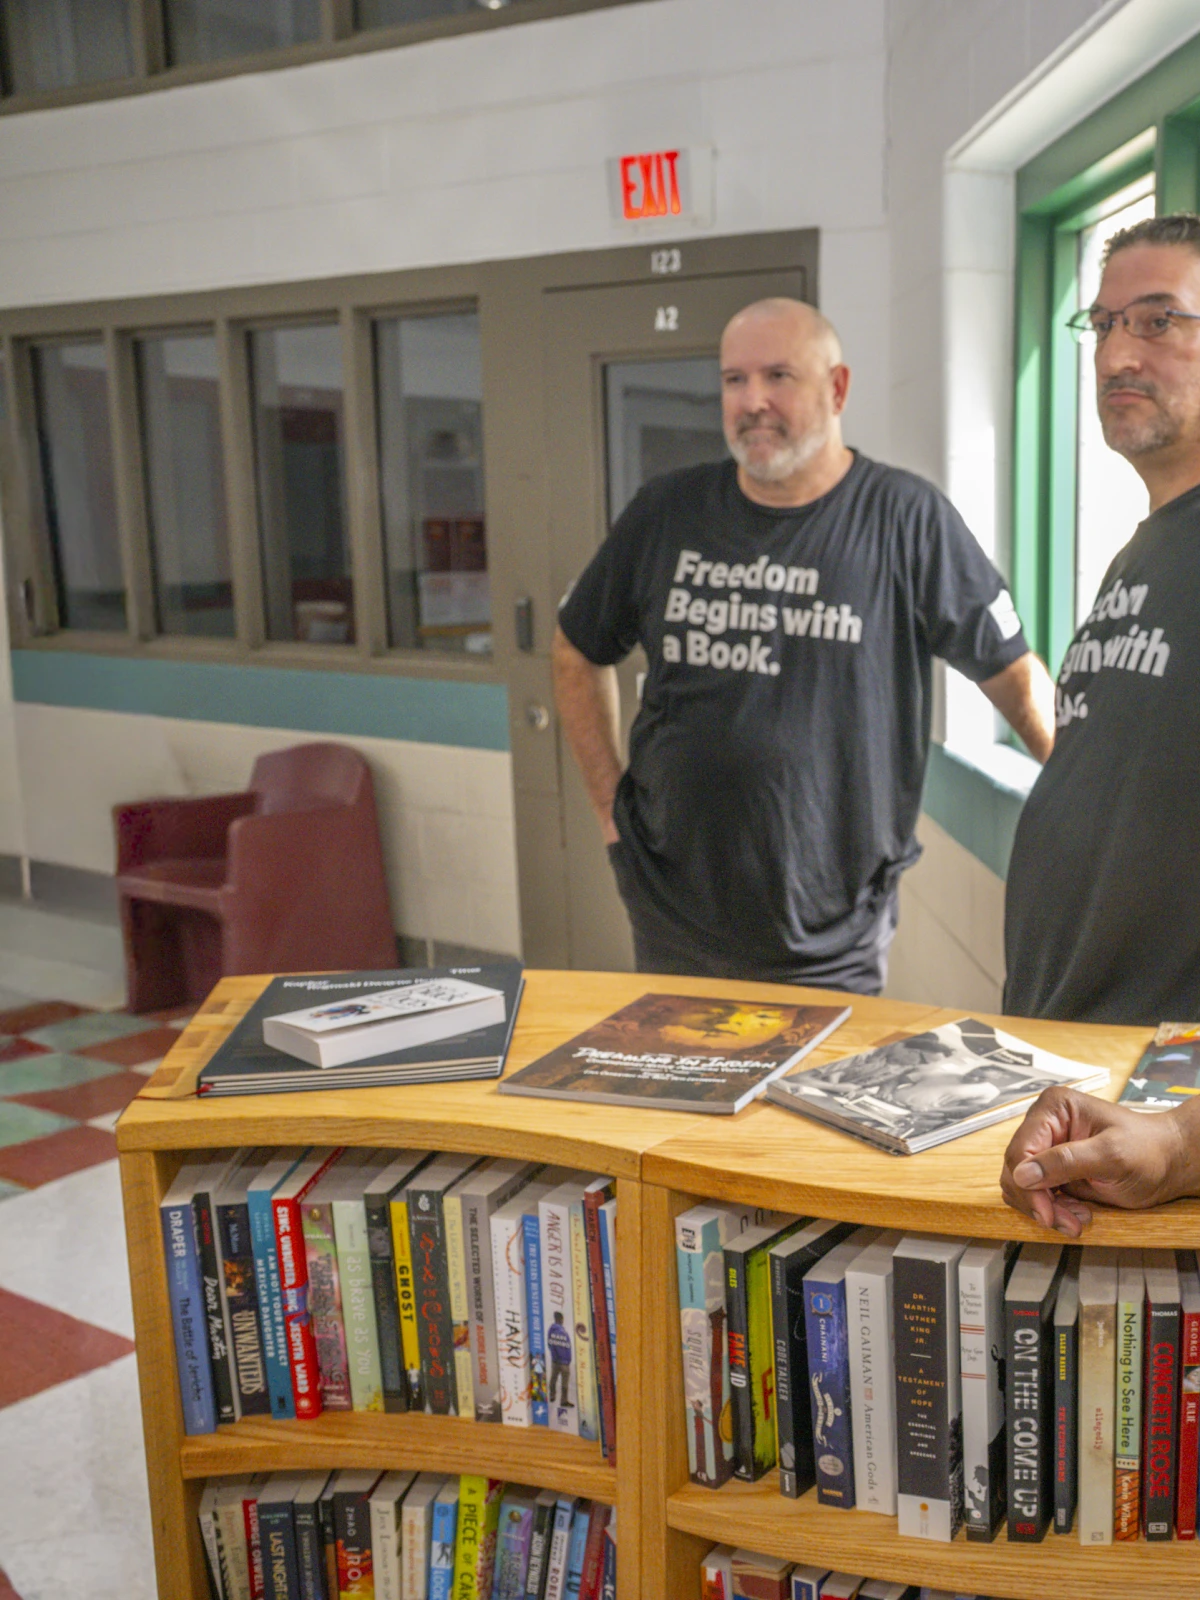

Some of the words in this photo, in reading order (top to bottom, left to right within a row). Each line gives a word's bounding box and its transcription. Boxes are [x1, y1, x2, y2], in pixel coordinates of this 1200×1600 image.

[620, 149, 682, 220] EXIT
[651, 249, 681, 273] 123
[654, 306, 679, 331] A2
[673, 549, 819, 596] Freedom
[663, 588, 778, 634] Begins
[782, 600, 863, 643] with
[662, 632, 681, 663] a
[686, 630, 782, 676] Book.
[1103, 624, 1170, 677] with
[276, 1206, 290, 1235] SING,
[469, 1207, 478, 1226] THE
[546, 1210, 561, 1254] ANGER
[587, 1208, 596, 1243] MARCH
[168, 1210, 186, 1258] DRAPER
[268, 1254, 277, 1270] AM
[279, 1235, 296, 1288] UNBURIED,
[469, 1227, 482, 1274] SELECTED
[528, 1242, 537, 1258] THE
[547, 1256, 562, 1267] IS
[256, 1259, 268, 1304] MEXICAN
[270, 1273, 279, 1293] NOT
[529, 1259, 539, 1281] STARS
[548, 1268, 562, 1278] A
[728, 1268, 737, 1289] GILES
[179, 1297, 191, 1315] The
[203, 1276, 219, 1311] Dear
[272, 1296, 282, 1322] YOUR
[286, 1288, 298, 1312] SING
[398, 1265, 414, 1323] GHOST
[472, 1277, 483, 1310] WORKS
[530, 1282, 540, 1314] BENEATH
[549, 1282, 565, 1309] GIFT
[858, 1286, 869, 1322] NEIL
[904, 1303, 937, 1313] MARTIN
[913, 1292, 927, 1301] DR.
[182, 1317, 195, 1344] Battle
[261, 1306, 275, 1358] DAUGHTER
[475, 1311, 484, 1324] OF
[531, 1316, 541, 1331] OUR
[904, 1314, 937, 1324] LUTHER
[910, 1326, 931, 1334] KING
[208, 1315, 226, 1360] Martin
[231, 1311, 265, 1395] UNWANTEDS
[275, 1325, 287, 1367] PERFECT
[289, 1321, 305, 1360] JESMYN
[476, 1324, 487, 1354] AUDRE
[505, 1309, 522, 1369] HAIKU
[533, 1332, 542, 1350] FEET
[686, 1329, 703, 1372] SQUIRE
[728, 1331, 746, 1368] FAKE
[776, 1339, 786, 1364] CODE
[818, 1318, 828, 1363] CHAINANI
[1013, 1328, 1039, 1362] ON
[1059, 1333, 1067, 1354] ELLEN
[1119, 1312, 1136, 1366] Nothing
[1189, 1321, 1199, 1358] GEORGE
[186, 1349, 198, 1361] of
[860, 1326, 873, 1386] GAIMAN
[294, 1363, 309, 1394] WARD
[477, 1356, 488, 1386] LORDE
[730, 1372, 747, 1388] ID
[777, 1365, 789, 1401] TALKER
[898, 1375, 945, 1387] TESTAMENT
[1122, 1371, 1135, 1384] to
[910, 1399, 933, 1408] HOPE
[1013, 1368, 1039, 1411] THE
[1122, 1388, 1135, 1413] See
[1151, 1342, 1175, 1436] CONCRETE
[1058, 1407, 1066, 1422] THE
[1186, 1401, 1196, 1424] JULIE
[863, 1404, 874, 1459] American
[1092, 1407, 1103, 1451] allegedly
[1121, 1417, 1134, 1448] Here
[1013, 1417, 1039, 1481] COME
[867, 1462, 878, 1491] Gods
[1149, 1439, 1170, 1499] ROSE
[1013, 1487, 1038, 1518] UP
[1120, 1475, 1131, 1500] Kevin
[248, 1504, 260, 1546] GEORGE
[345, 1507, 357, 1537] ZHAO
[462, 1504, 478, 1545] PIECE
[1120, 1503, 1130, 1533] Wilson
[269, 1532, 285, 1556] LAST
[531, 1531, 544, 1555] JASON
[252, 1549, 263, 1592] ORWELL
[272, 1559, 288, 1592] NIGHT
[345, 1547, 361, 1594] IRON
[527, 1556, 543, 1594] REYNOLDS
